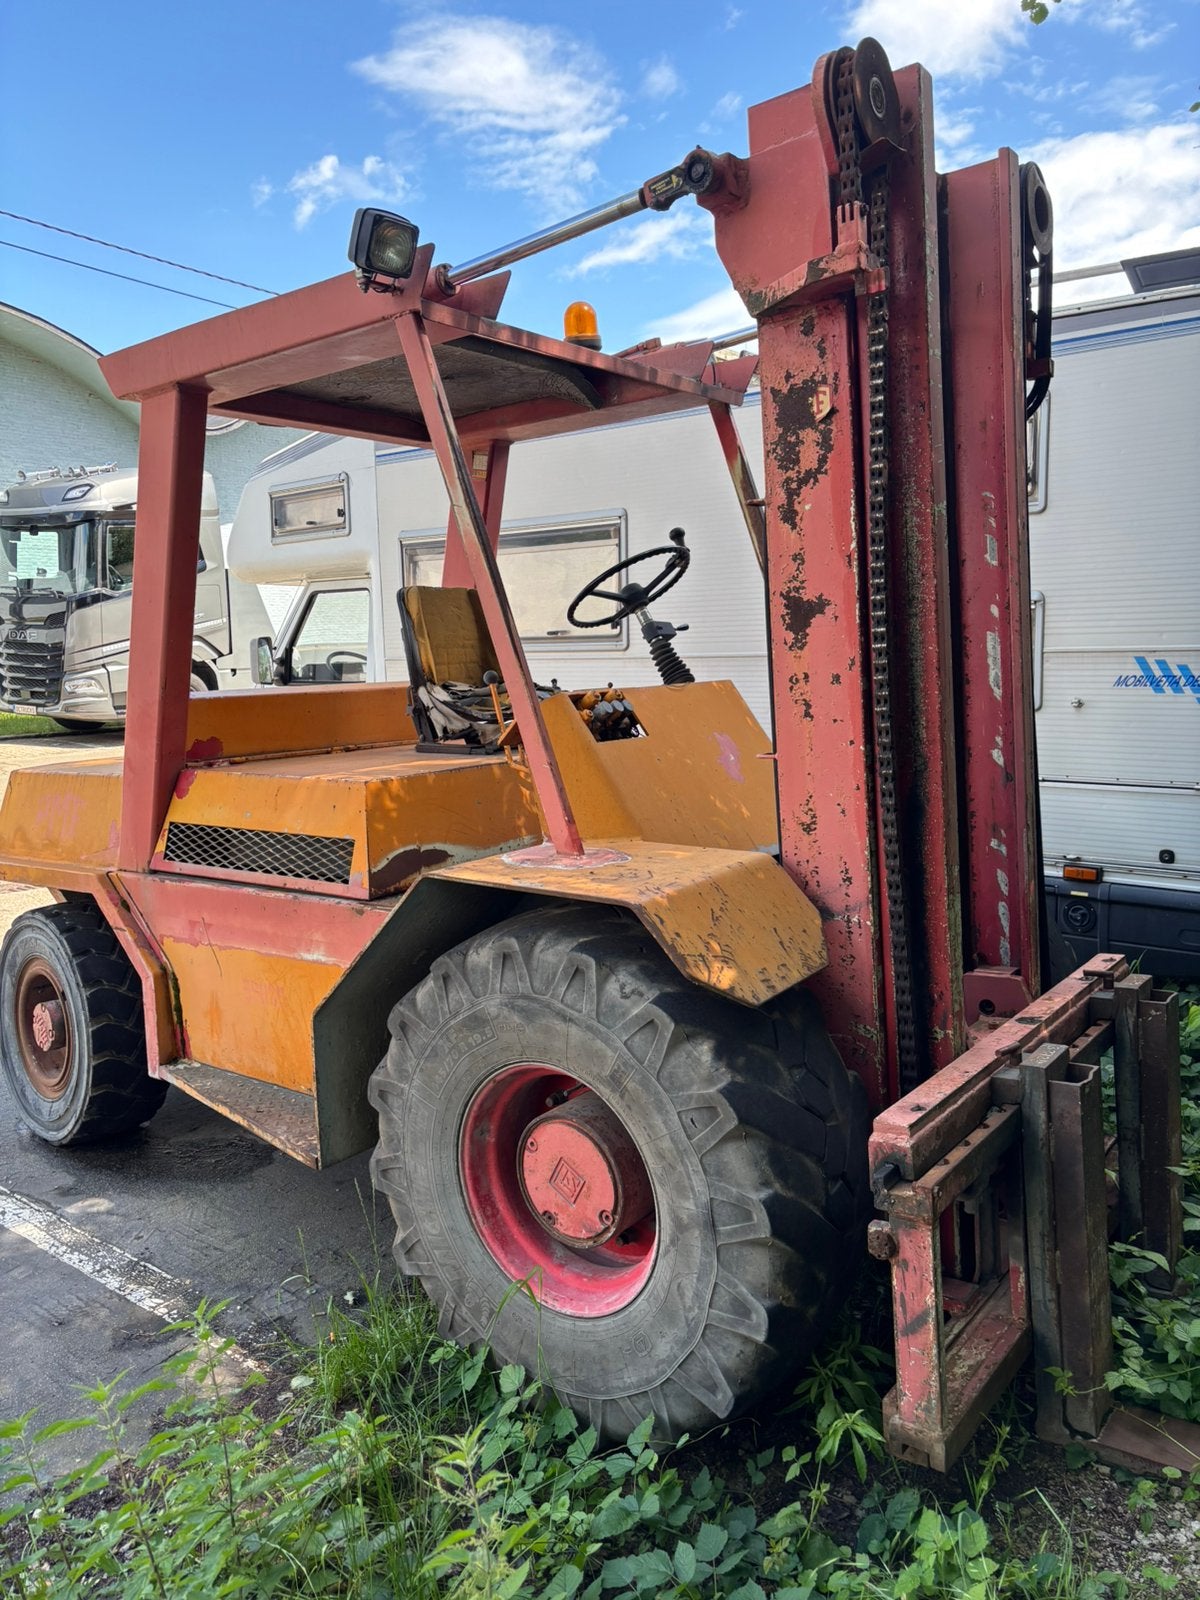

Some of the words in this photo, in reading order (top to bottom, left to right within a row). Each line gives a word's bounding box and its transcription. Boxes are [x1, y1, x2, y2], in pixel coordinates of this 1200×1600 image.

[9, 630, 37, 640] DAF
[1113, 675, 1182, 687] MOBILVETTA
[468, 1025, 493, 1046] 19.5
